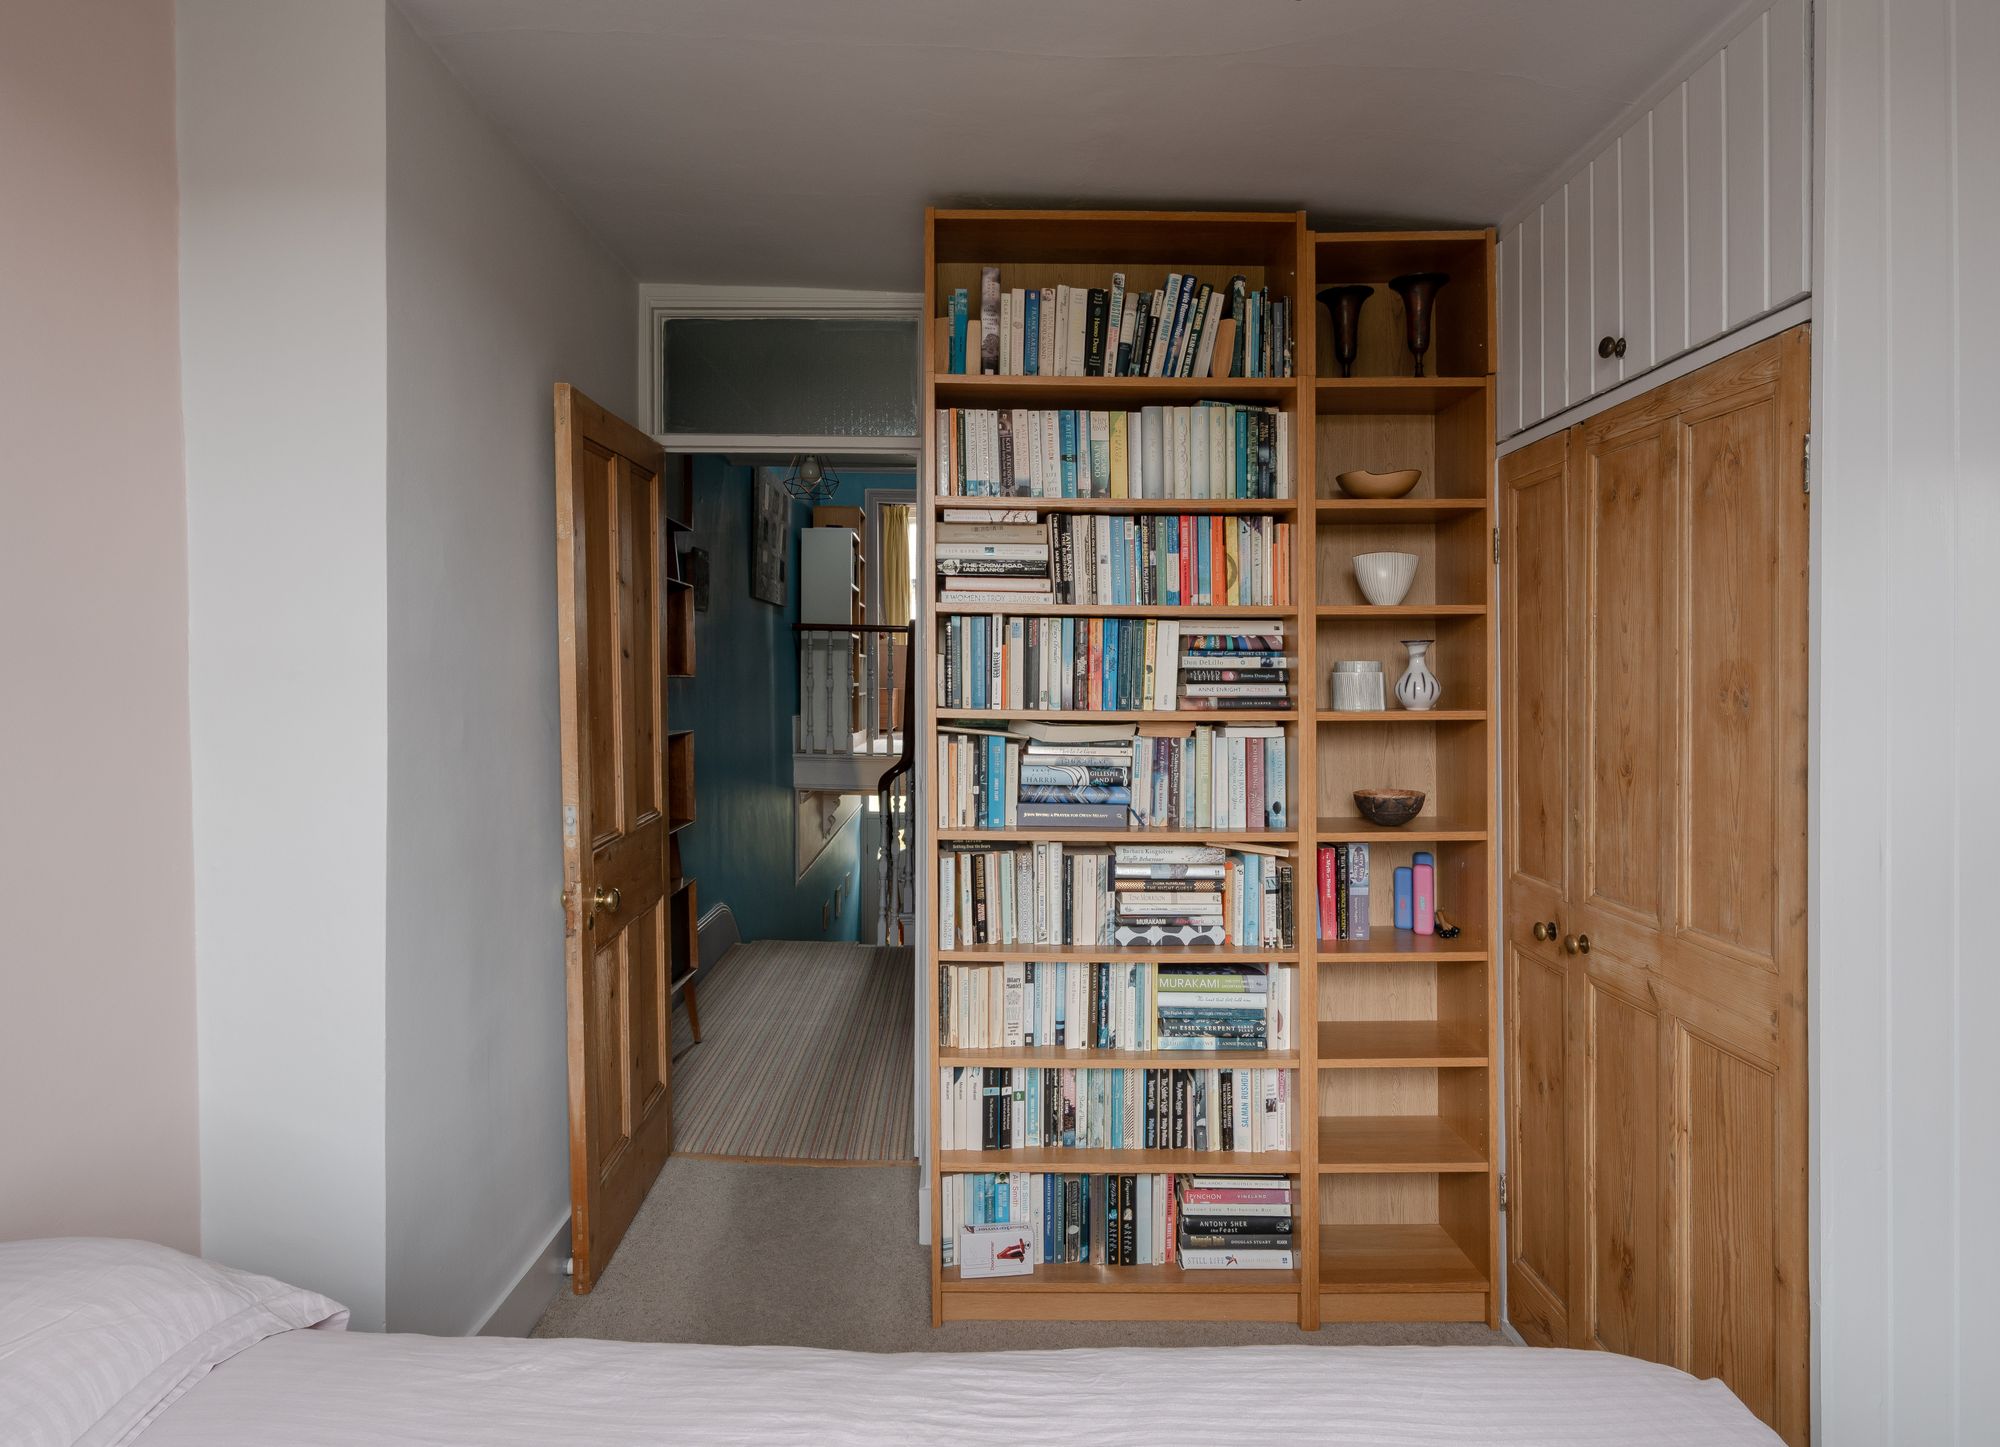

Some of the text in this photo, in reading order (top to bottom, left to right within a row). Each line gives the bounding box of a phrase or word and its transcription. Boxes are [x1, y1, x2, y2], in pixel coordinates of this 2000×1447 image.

[1167, 278, 1179, 306] MIRACLE
[1184, 278, 1194, 291] Why
[1111, 292, 1122, 328] SANDSTORM
[1192, 286, 1209, 330] ANTONY SHER
[1092, 318, 1100, 337] Homo
[1160, 320, 1171, 342] ANDES
[1174, 303, 1188, 338] Remember
[1188, 333, 1197, 346] YEAR
[1160, 978, 1219, 988] MURAKAMI
